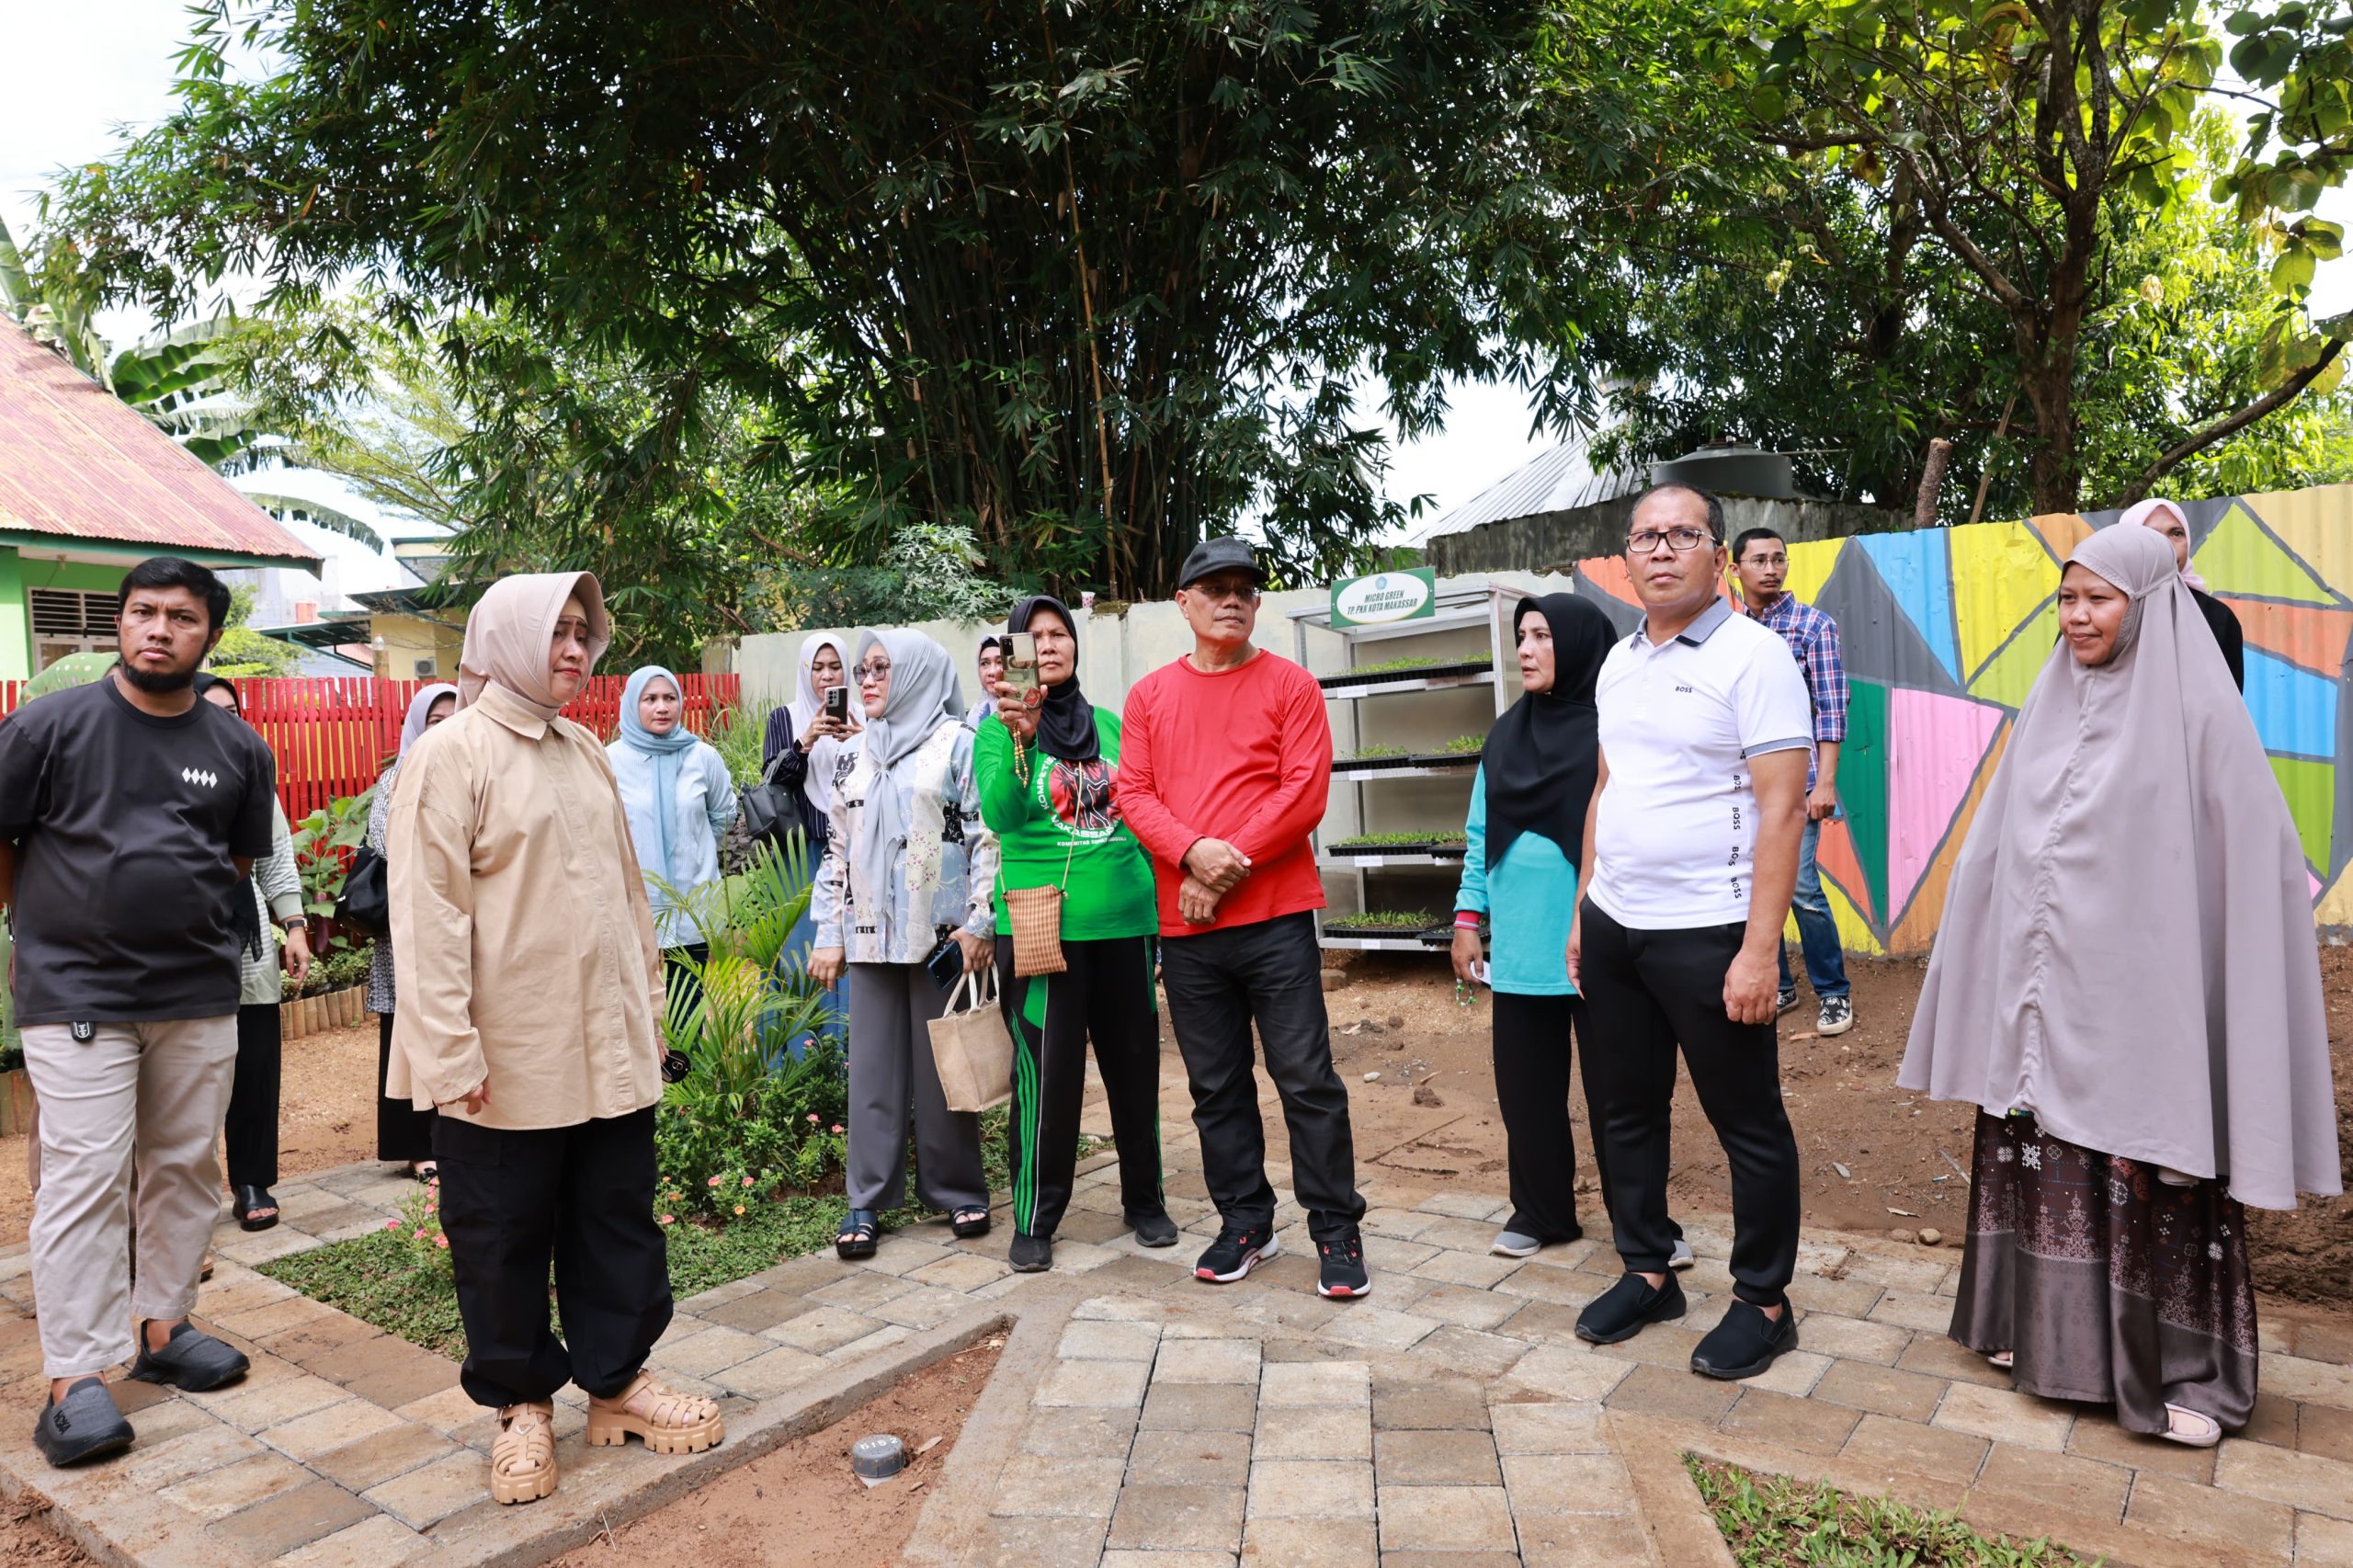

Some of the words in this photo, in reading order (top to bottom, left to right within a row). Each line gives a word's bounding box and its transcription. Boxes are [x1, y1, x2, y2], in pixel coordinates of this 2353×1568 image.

[1364, 591, 1384, 603] MICRO
[1384, 589, 1404, 600] GREEN
[1368, 602, 1383, 613] KOTA
[1383, 597, 1418, 610] MAKASSAR
[1675, 686, 1693, 694] BOSS
[1732, 807, 1741, 830] BOSS
[1730, 877, 1742, 899] BOSS
[53, 1410, 72, 1435] HOKA
